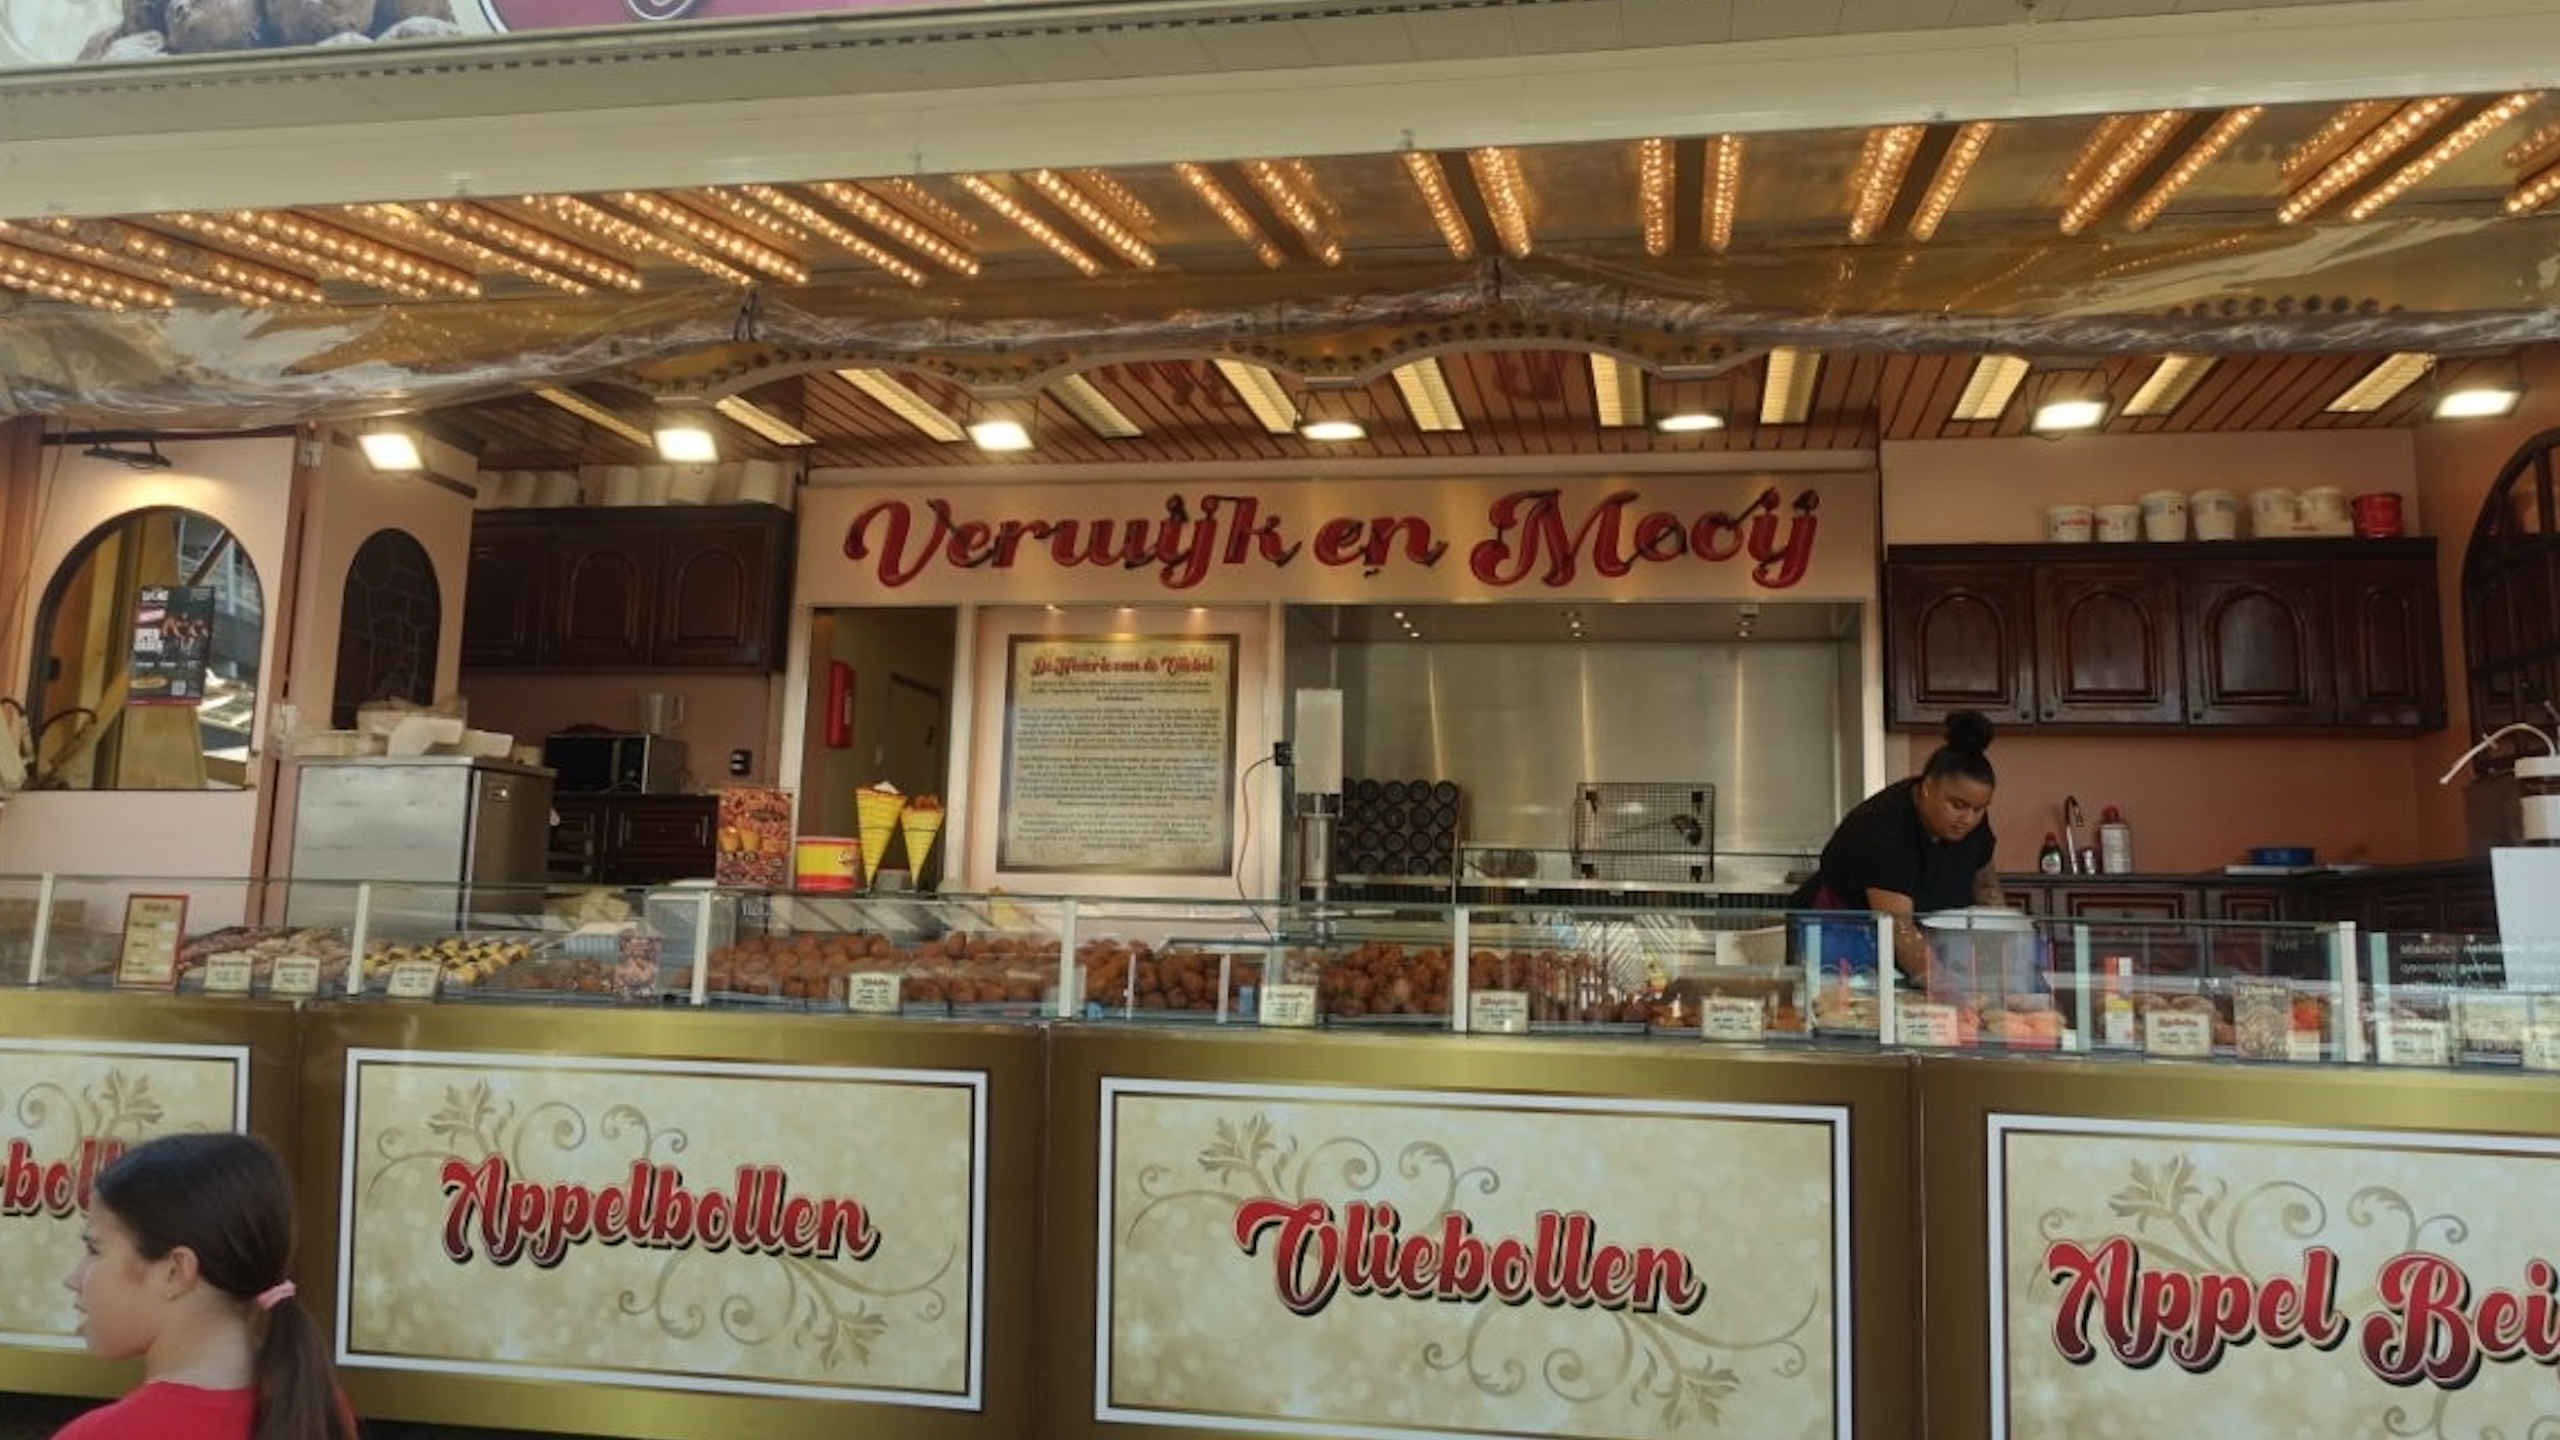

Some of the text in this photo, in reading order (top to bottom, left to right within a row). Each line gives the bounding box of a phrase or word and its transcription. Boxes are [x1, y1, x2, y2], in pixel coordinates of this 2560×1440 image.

[843, 487, 1820, 589] Verwijk en Mooij
[0, 1137, 124, 1218] bol
[440, 1153, 882, 1269] Appelbollen
[1233, 1198, 1707, 1316] Oliebollen
[2045, 1234, 2560, 1390] Appel Bei
